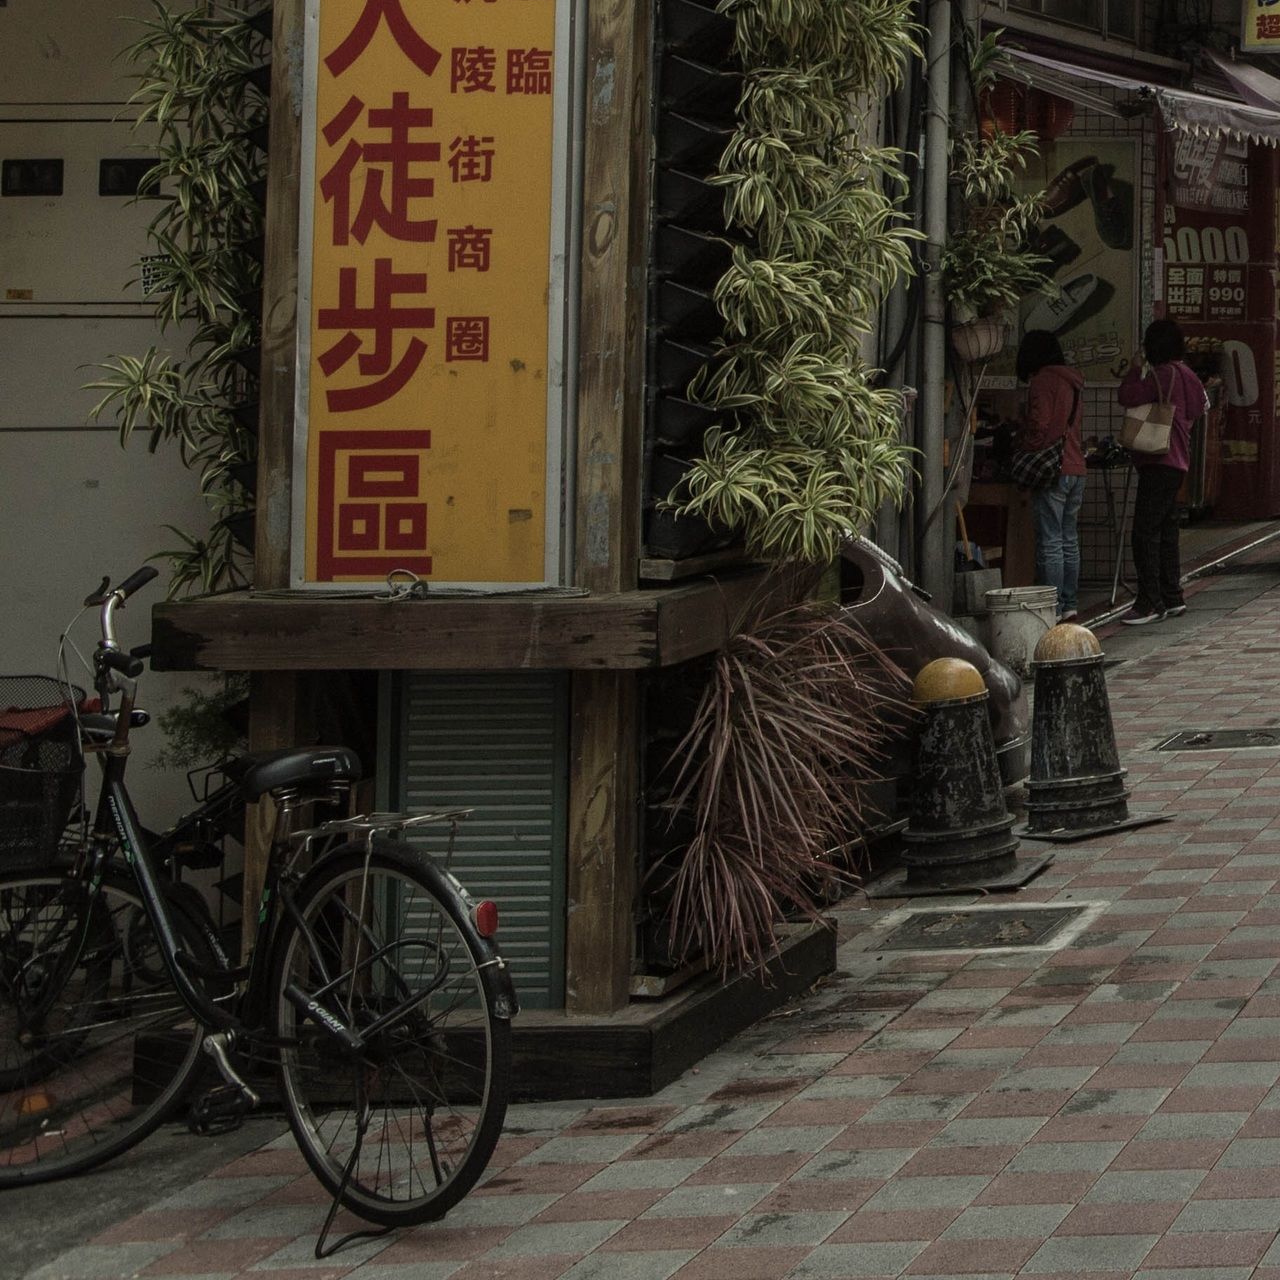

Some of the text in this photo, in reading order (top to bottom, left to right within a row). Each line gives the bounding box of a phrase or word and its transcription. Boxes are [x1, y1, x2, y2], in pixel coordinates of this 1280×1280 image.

[1167, 267, 1204, 286] 全面
[1213, 268, 1241, 284] 特價
[1167, 286, 1203, 305] 出清
[1208, 286, 1245, 302] 990
[315, 1007, 346, 1031] GIANT
